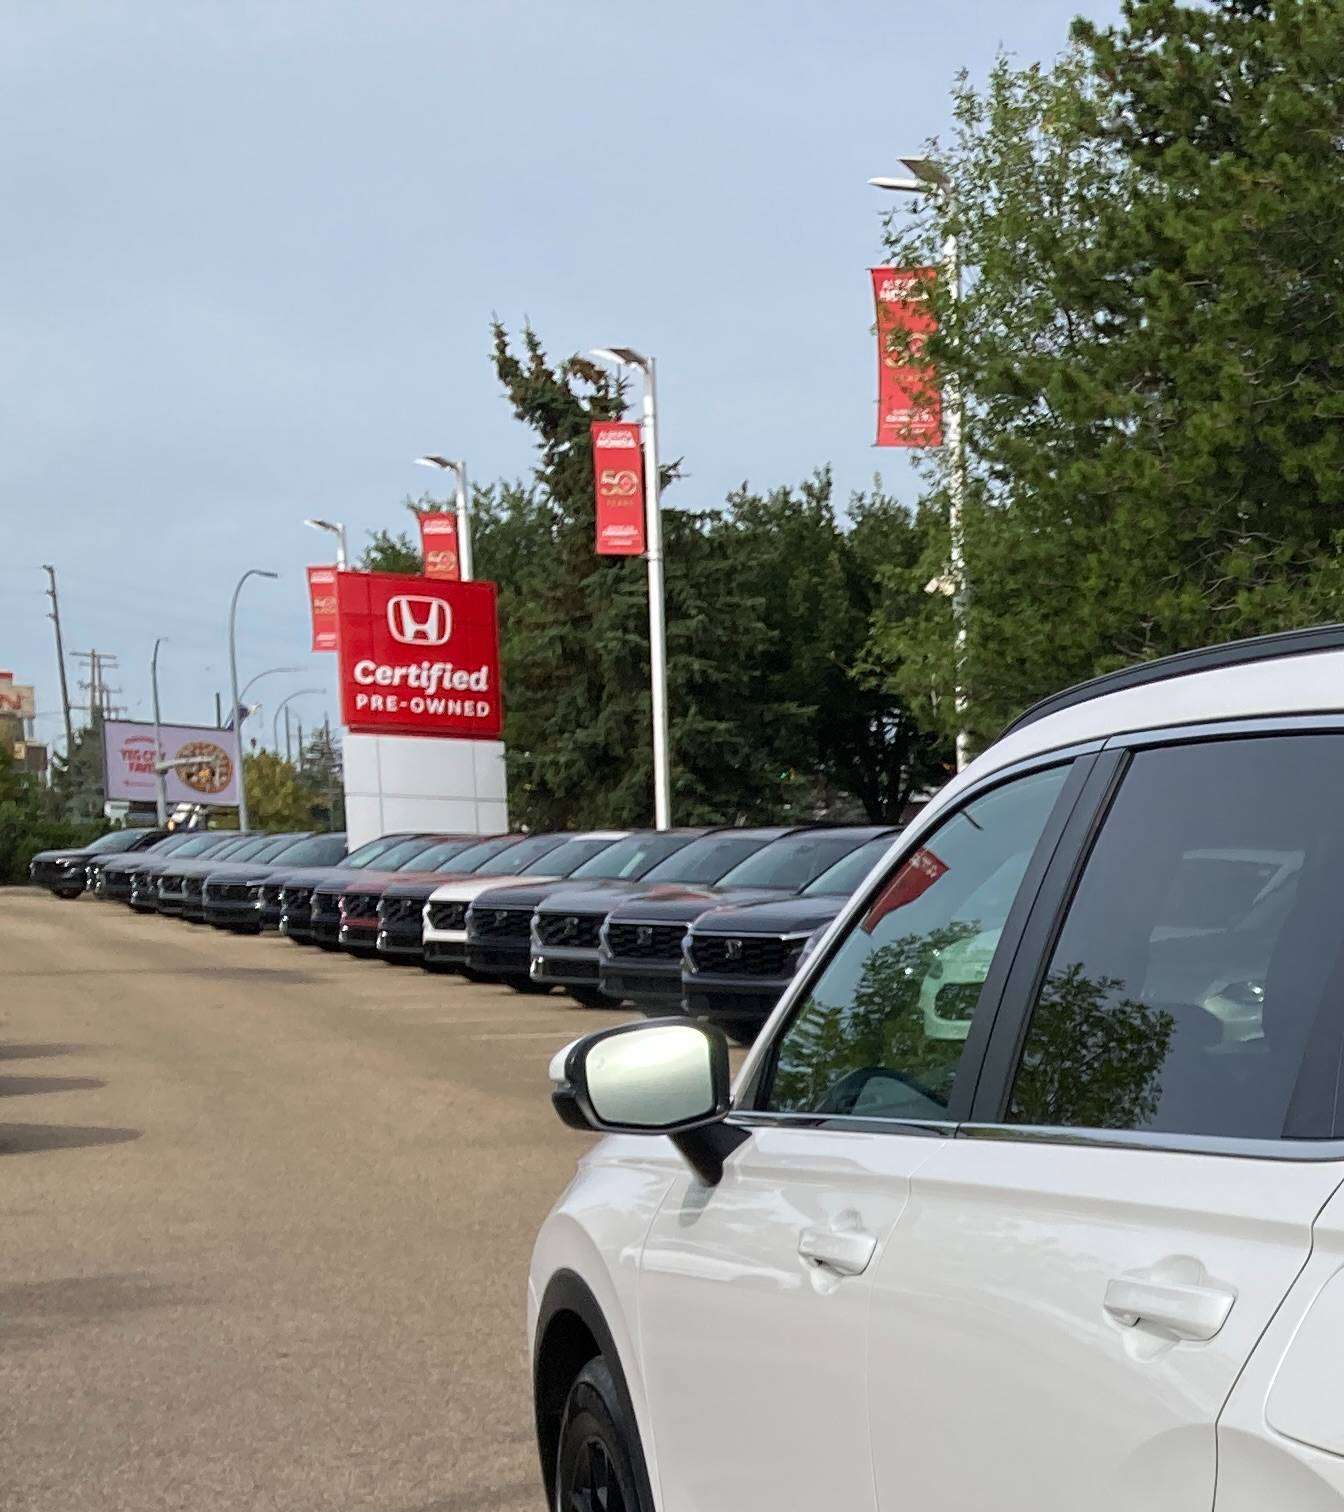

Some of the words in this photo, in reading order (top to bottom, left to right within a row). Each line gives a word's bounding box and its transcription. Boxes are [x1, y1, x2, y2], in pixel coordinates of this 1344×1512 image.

[600, 470, 638, 496] 50
[353, 659, 489, 695] Certified
[355, 694, 491, 718] PRE-OWNED
